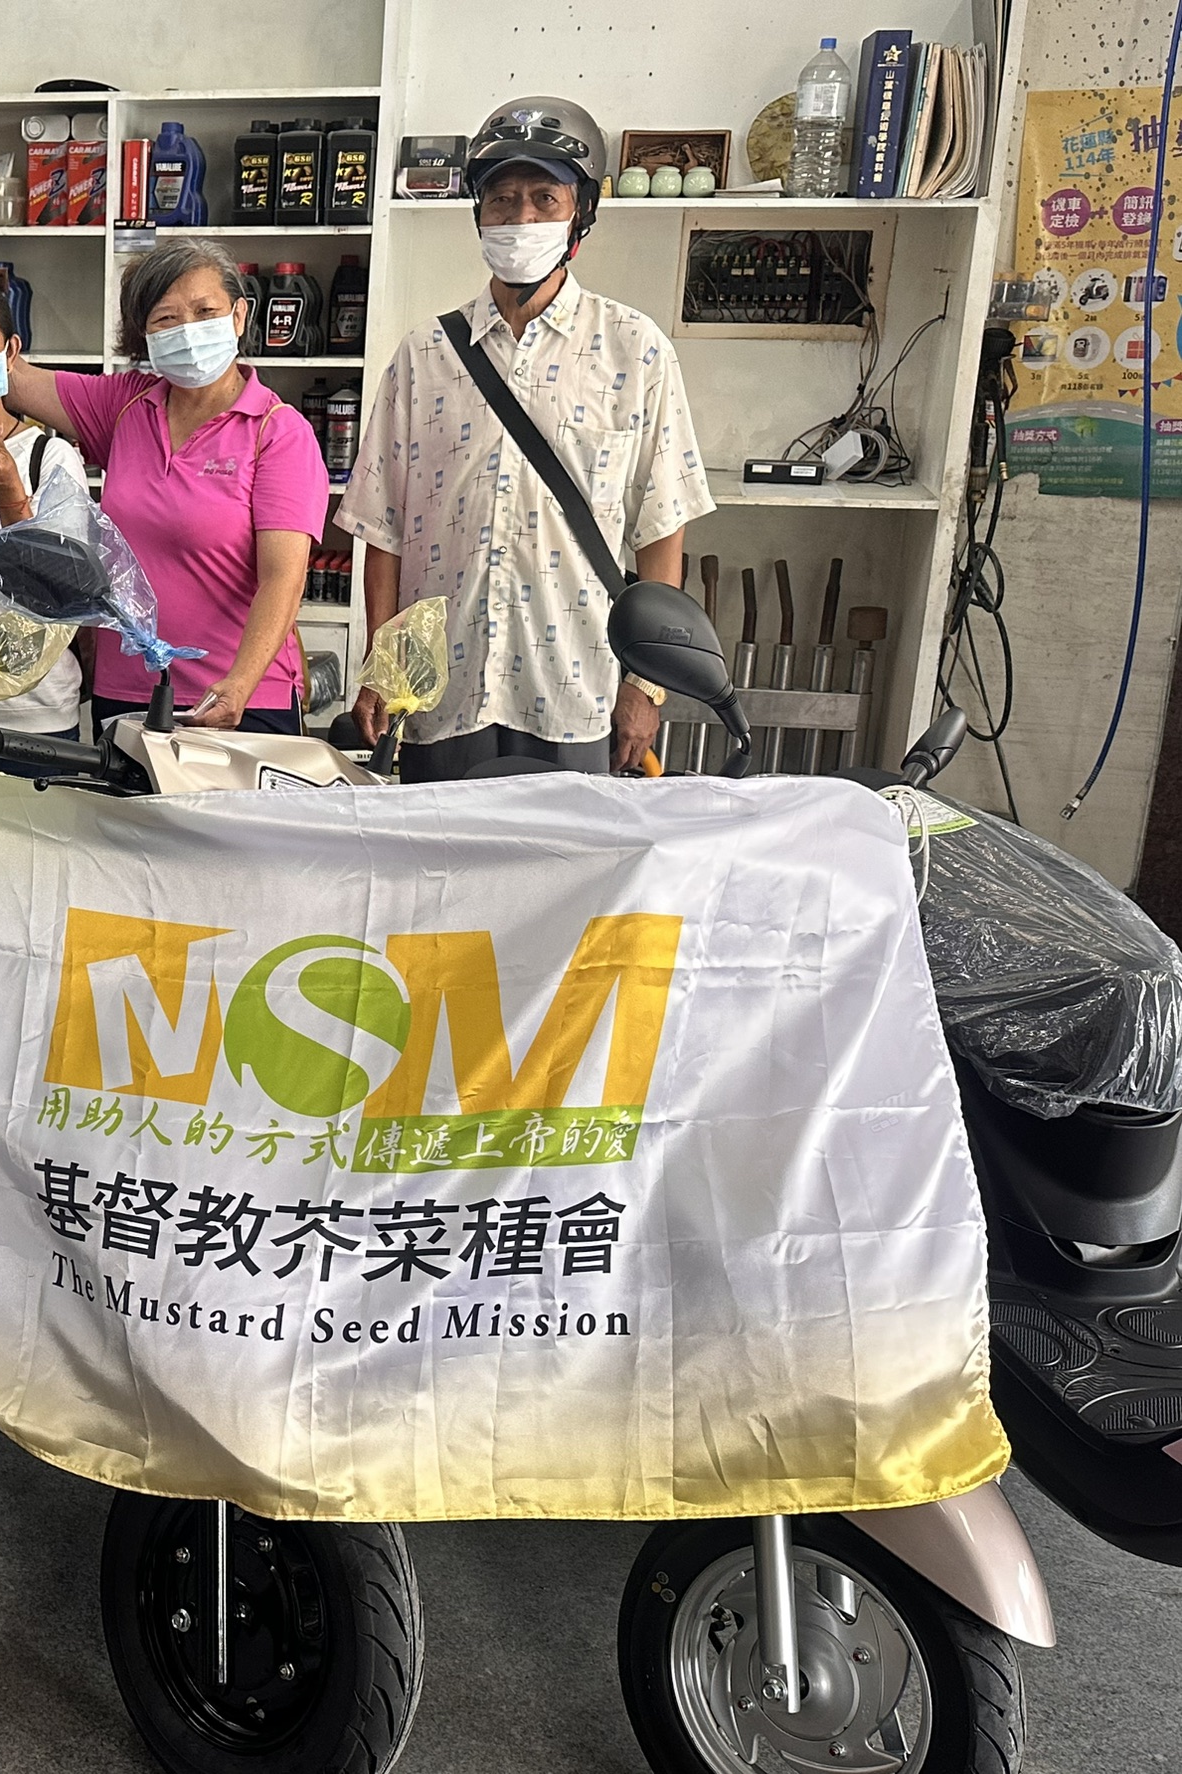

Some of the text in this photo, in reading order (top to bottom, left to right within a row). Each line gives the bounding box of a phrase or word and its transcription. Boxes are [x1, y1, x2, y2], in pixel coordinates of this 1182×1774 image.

[1062, 129, 1115, 154] 花蓮縣
[1065, 147, 1115, 171] 114年
[1013, 430, 1058, 442] 抽獎方式
[43, 906, 683, 1117] NSM
[36, 1087, 639, 1169] 用助人的方式 傳遞上帝的愛
[34, 1157, 626, 1282] 基督教芥菜種會
[52, 1251, 631, 1344] The Mustard Seed Mission
